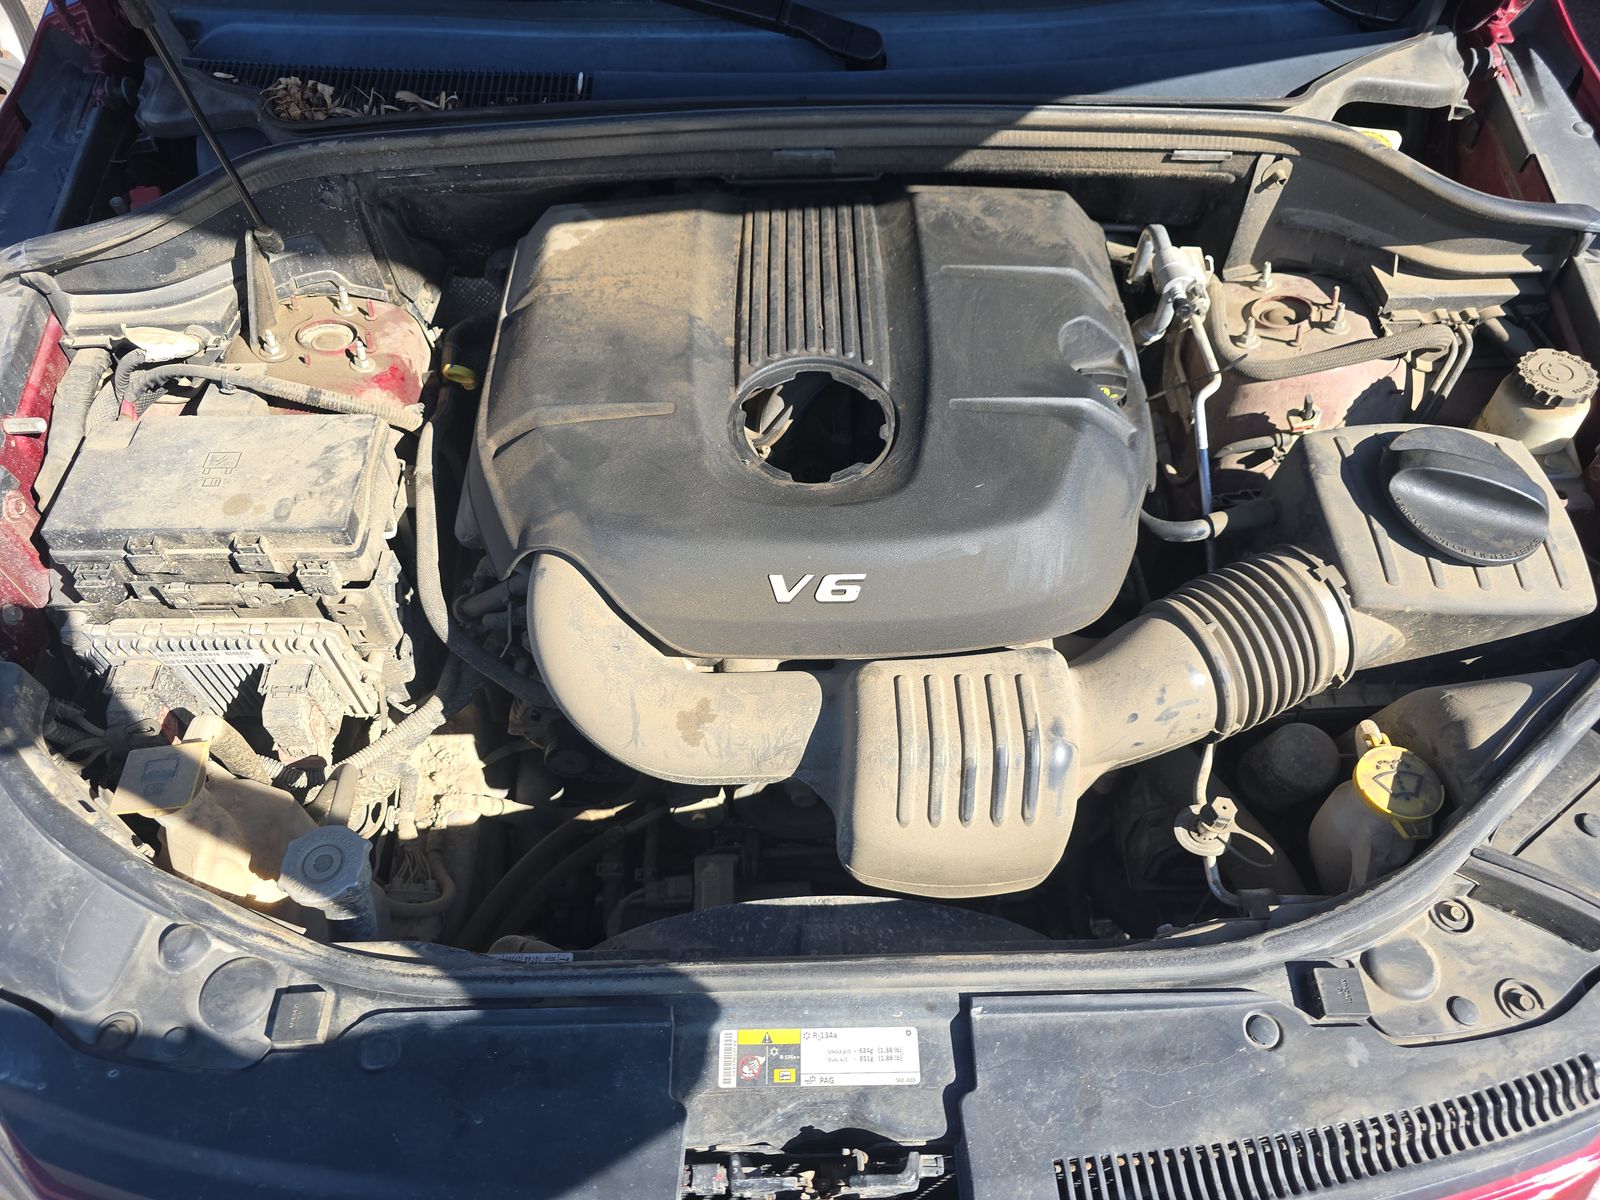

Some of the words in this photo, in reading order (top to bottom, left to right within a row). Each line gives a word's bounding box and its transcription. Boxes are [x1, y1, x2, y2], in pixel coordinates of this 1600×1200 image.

[767, 573, 867, 604] V6
[812, 1031, 838, 1040] R-134a
[819, 1076, 835, 1085] PAG
